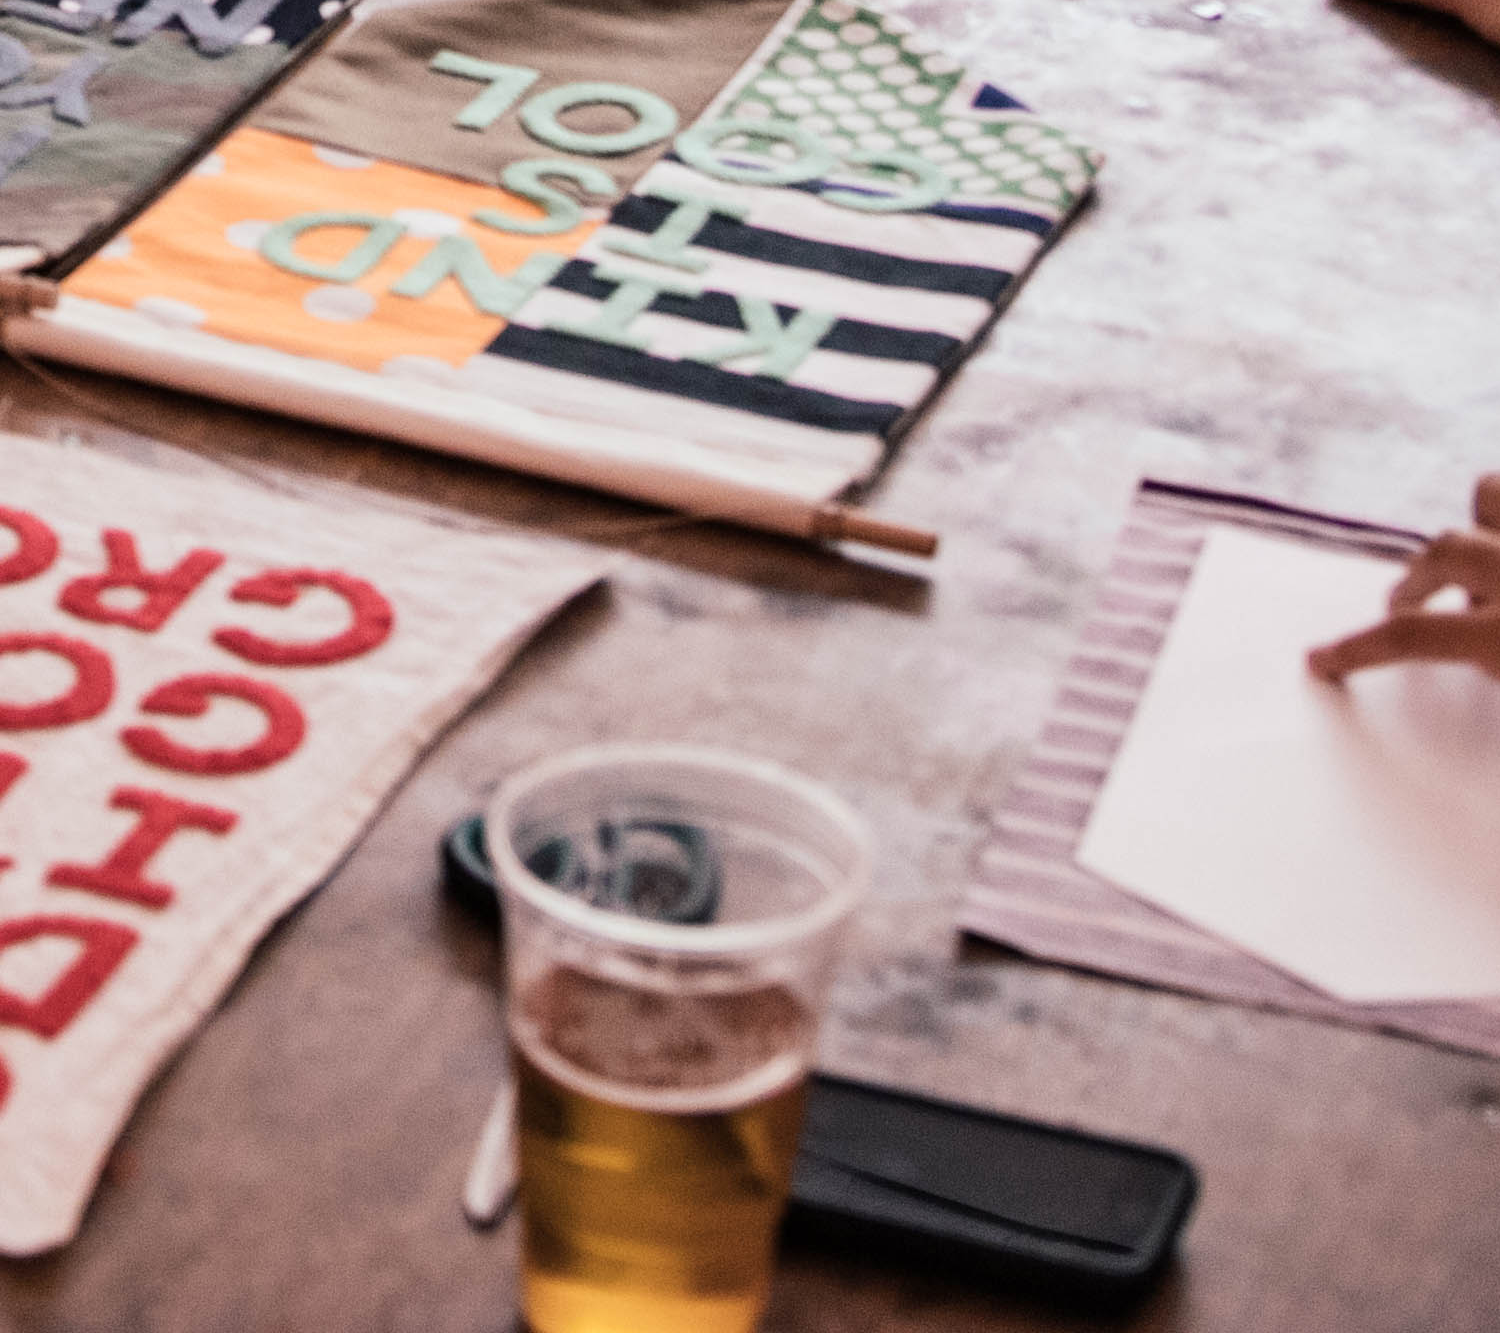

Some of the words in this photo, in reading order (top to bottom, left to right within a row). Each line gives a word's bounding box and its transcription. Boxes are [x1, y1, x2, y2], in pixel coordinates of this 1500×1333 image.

[431, 50, 953, 213] COOL
[258, 211, 840, 381] KIND
[473, 157, 750, 273] IS
